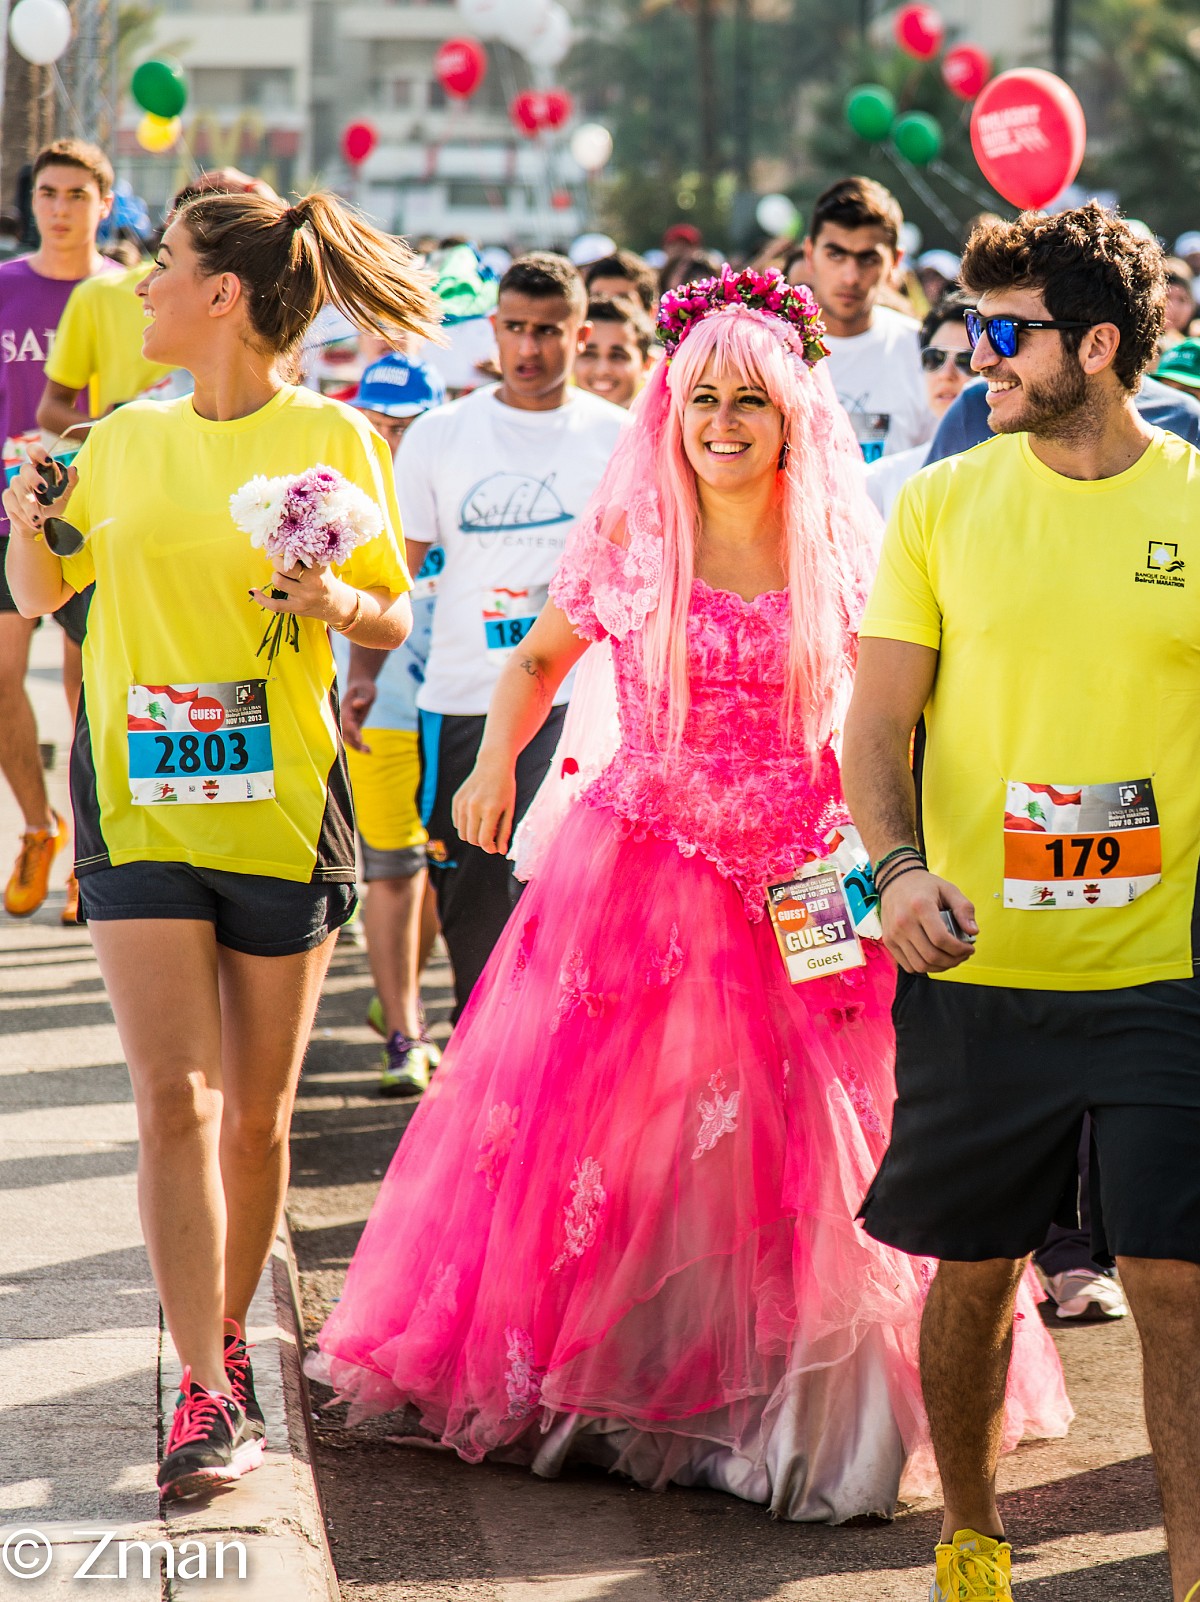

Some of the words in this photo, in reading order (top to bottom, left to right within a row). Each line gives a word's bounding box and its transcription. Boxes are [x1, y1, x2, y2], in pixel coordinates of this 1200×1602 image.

[190, 708, 222, 720] GUEST
[225, 717, 238, 725] NOV
[154, 732, 249, 774] 2803
[1134, 816, 1150, 824] 2013
[1045, 836, 1121, 878] 179
[820, 886, 836, 896] 2013
[777, 908, 806, 921] GUEST
[786, 920, 847, 953] GUEST
[807, 951, 844, 969] Guest
